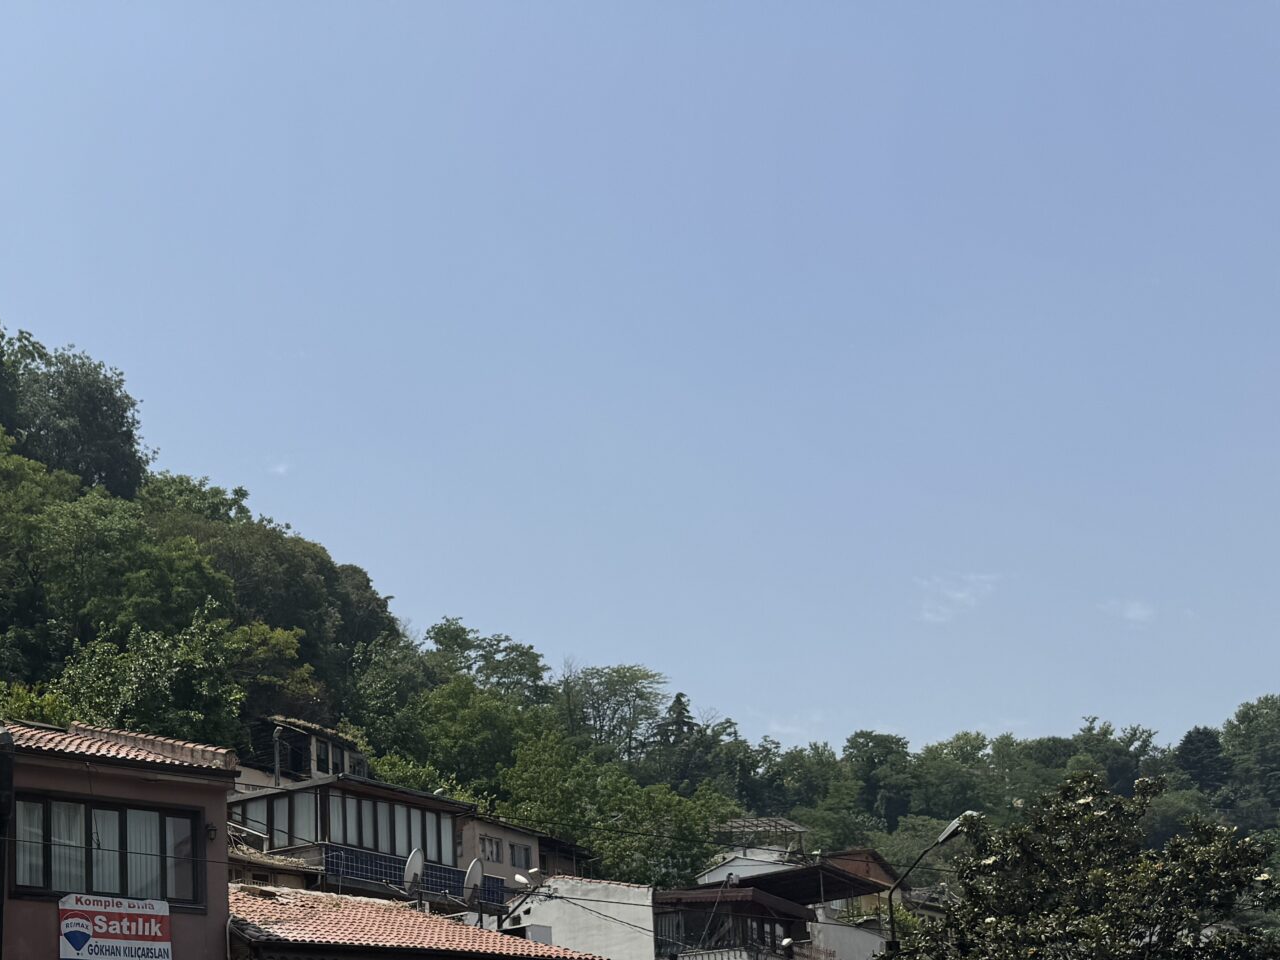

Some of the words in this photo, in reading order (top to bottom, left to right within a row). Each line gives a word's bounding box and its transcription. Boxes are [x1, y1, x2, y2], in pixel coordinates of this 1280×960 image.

[75, 896, 123, 909] Komple
[65, 921, 89, 930] RE/MAX
[93, 915, 163, 937] Satılık
[87, 941, 121, 957] GÖKHAN
[123, 945, 170, 960] KILIÇARSLAN
